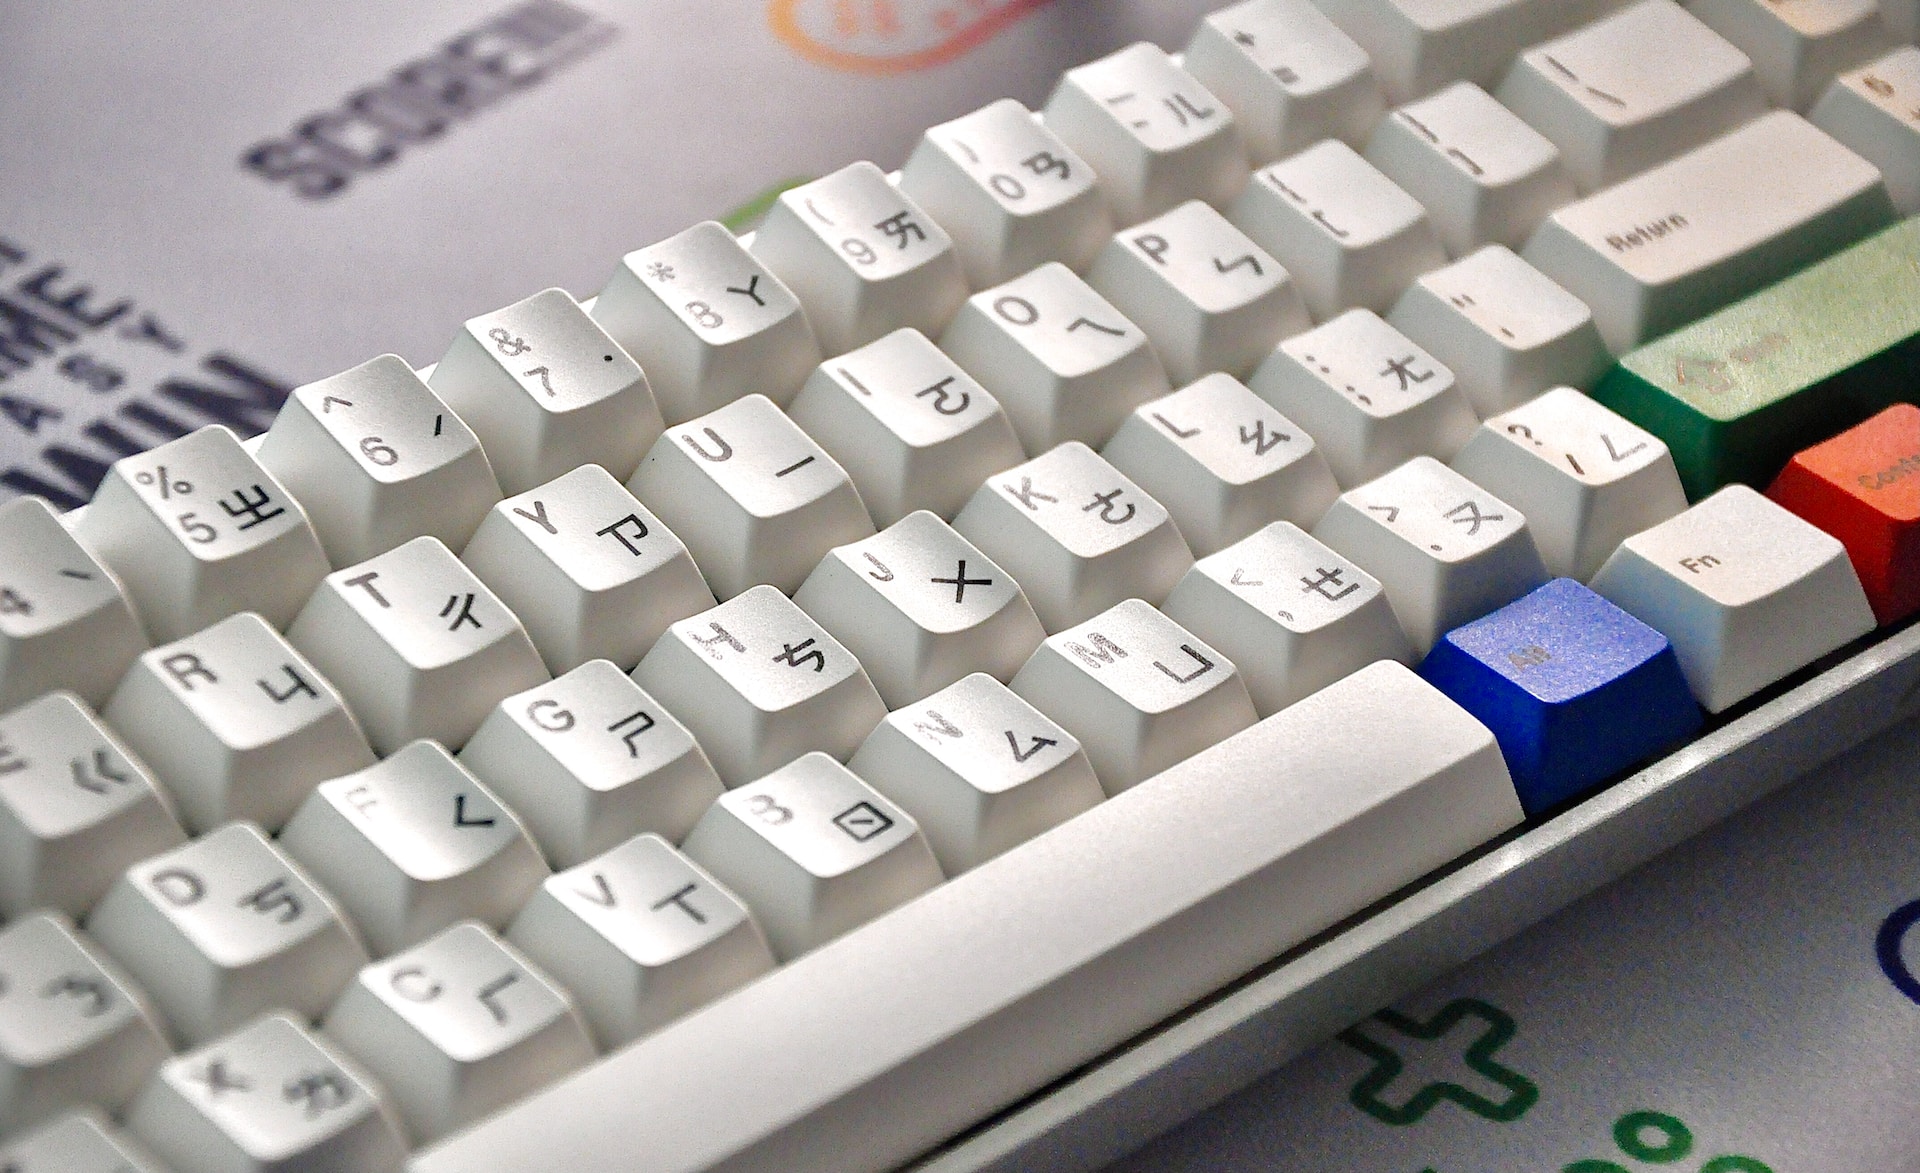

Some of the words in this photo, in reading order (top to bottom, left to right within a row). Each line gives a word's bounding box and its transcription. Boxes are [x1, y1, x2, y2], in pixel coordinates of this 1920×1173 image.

[989, 173, 1026, 200] 0
[1133, 233, 1170, 265] P
[1605, 213, 1690, 253] Return
[840, 237, 877, 265] 9
[684, 300, 724, 329] 8
[993, 296, 1040, 326] O
[523, 366, 556, 399] 7
[1152, 412, 1201, 439] L
[360, 436, 399, 466] 6
[681, 427, 733, 462] U
[136, 466, 192, 499] %
[1003, 476, 1059, 511] K
[178, 512, 217, 543] 5
[513, 501, 558, 535] Y
[862, 551, 894, 583] J
[1678, 554, 1721, 574] Fn
[344, 572, 391, 609] T
[1064, 631, 1129, 669] M
[162, 652, 218, 691] R
[527, 699, 575, 732] G
[152, 868, 205, 905] D
[575, 874, 617, 909] V
[389, 967, 442, 1002] C
